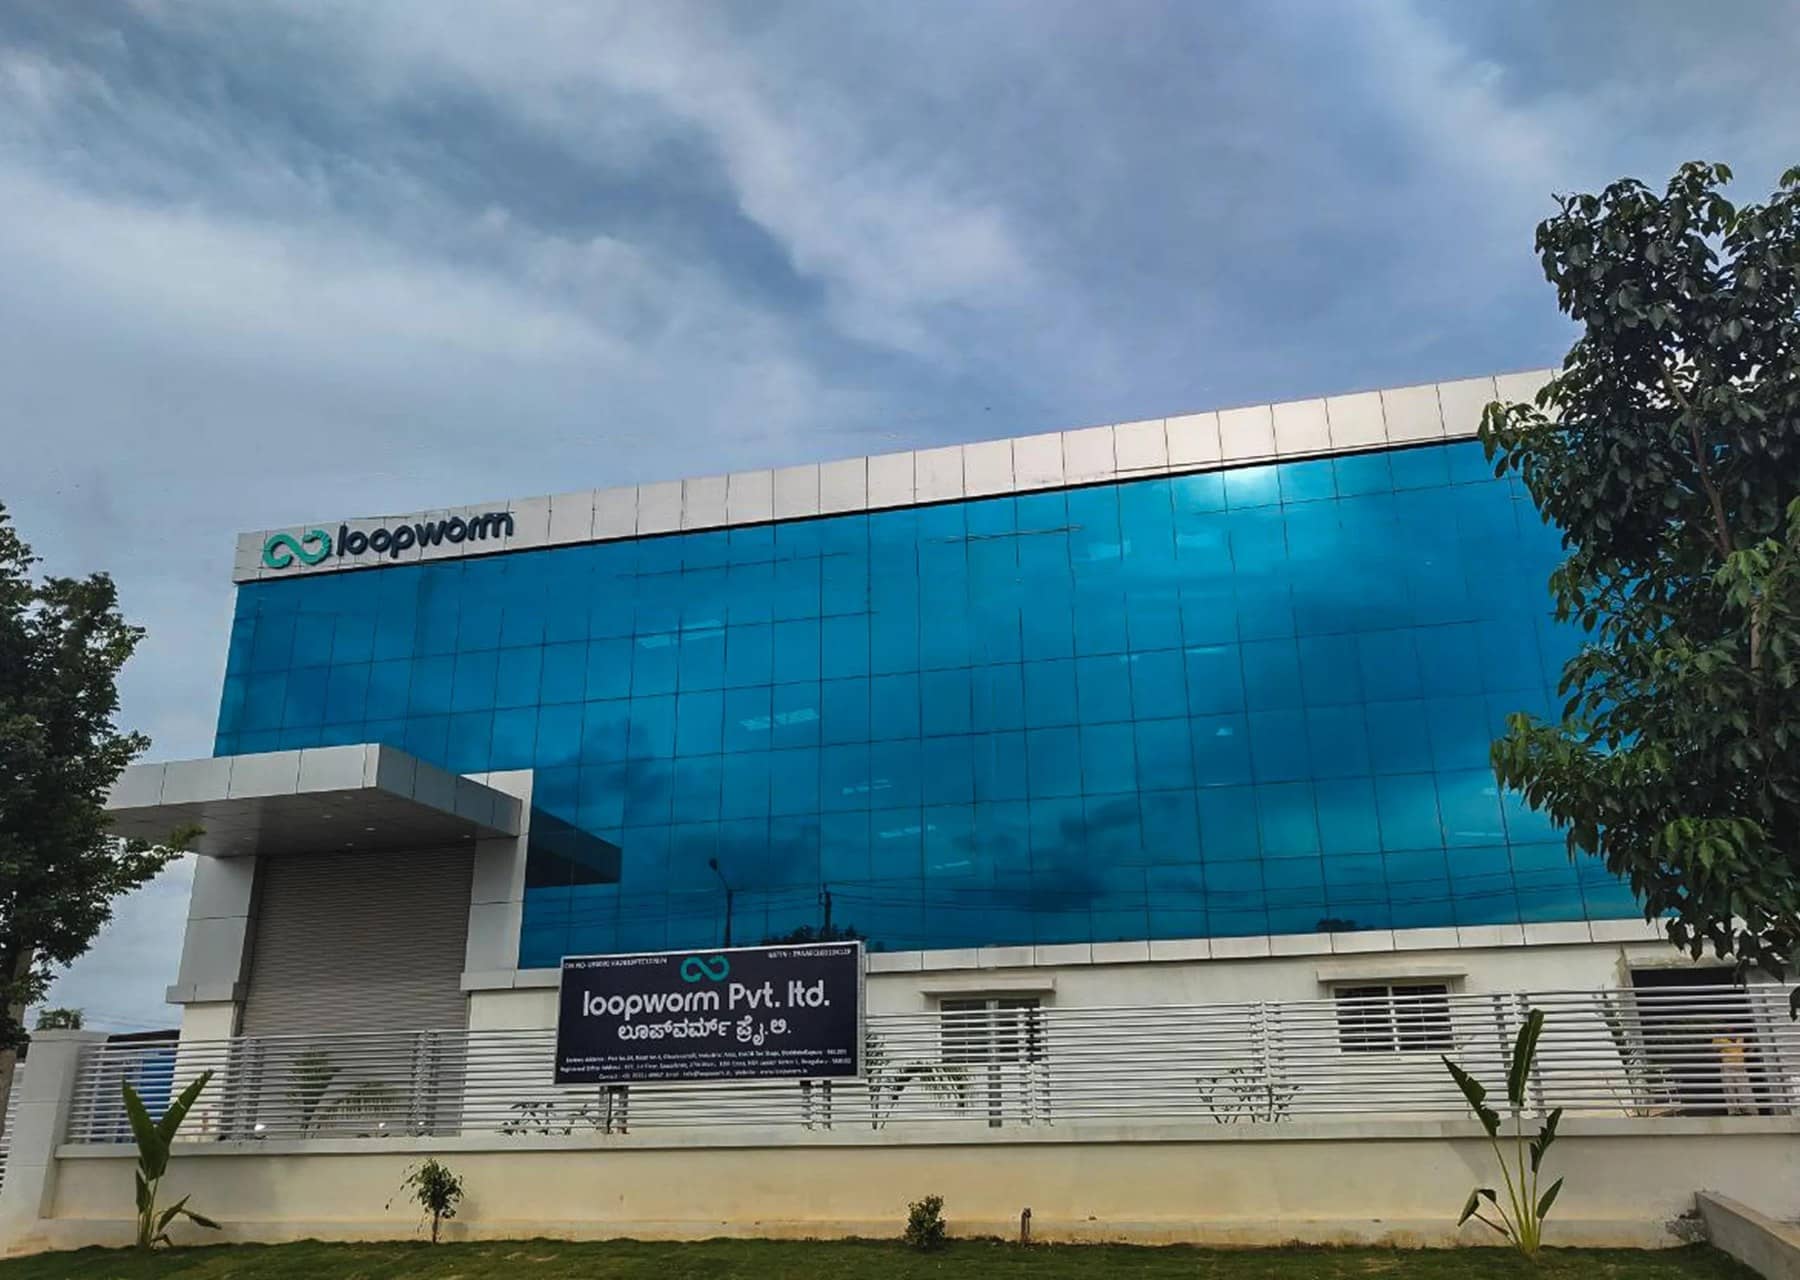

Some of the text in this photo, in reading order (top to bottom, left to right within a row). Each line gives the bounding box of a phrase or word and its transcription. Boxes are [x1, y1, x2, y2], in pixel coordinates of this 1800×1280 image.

[335, 511, 514, 558] loopworm
[583, 990, 720, 1021] loopworm
[728, 981, 781, 1010] Pvt.
